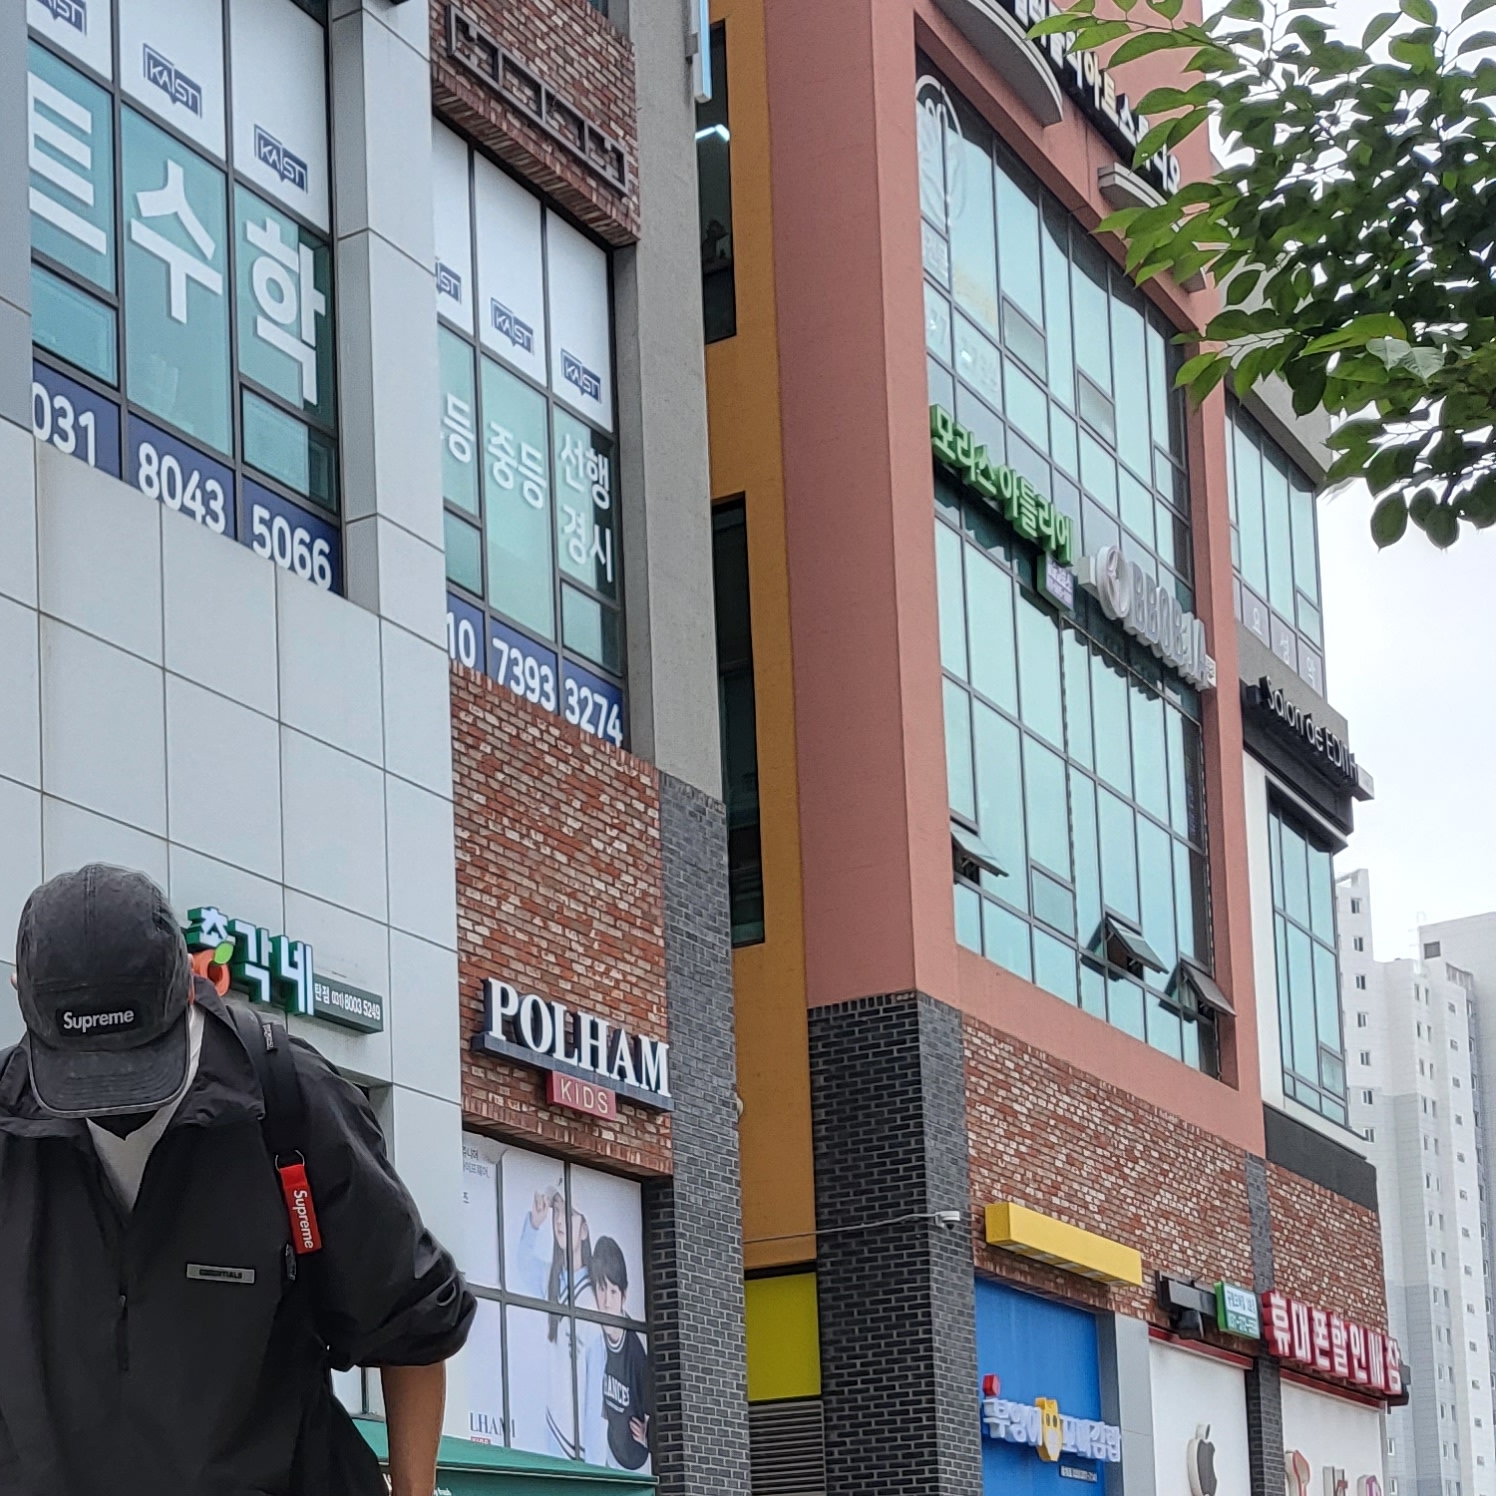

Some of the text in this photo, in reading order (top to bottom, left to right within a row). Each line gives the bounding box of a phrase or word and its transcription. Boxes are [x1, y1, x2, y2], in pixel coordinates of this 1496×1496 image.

[32, 380, 333, 592] 031 8043 5066
[487, 420, 548, 511] 중등
[560, 432, 611, 511] 선행
[562, 503, 614, 583] 경시
[492, 637, 557, 713] 7393
[564, 678, 624, 747] 3274
[1265, 674, 1359, 786] Salon de EDITH
[188, 905, 315, 1016] 총각네
[63, 1008, 135, 1033] Supreme
[488, 977, 672, 1098] POLHAM
[559, 1077, 610, 1115] KIDS
[292, 1189, 315, 1250] Supreme
[1271, 1290, 1402, 1395] 휴대폰할인매장
[983, 1397, 1043, 1447] 부엉이
